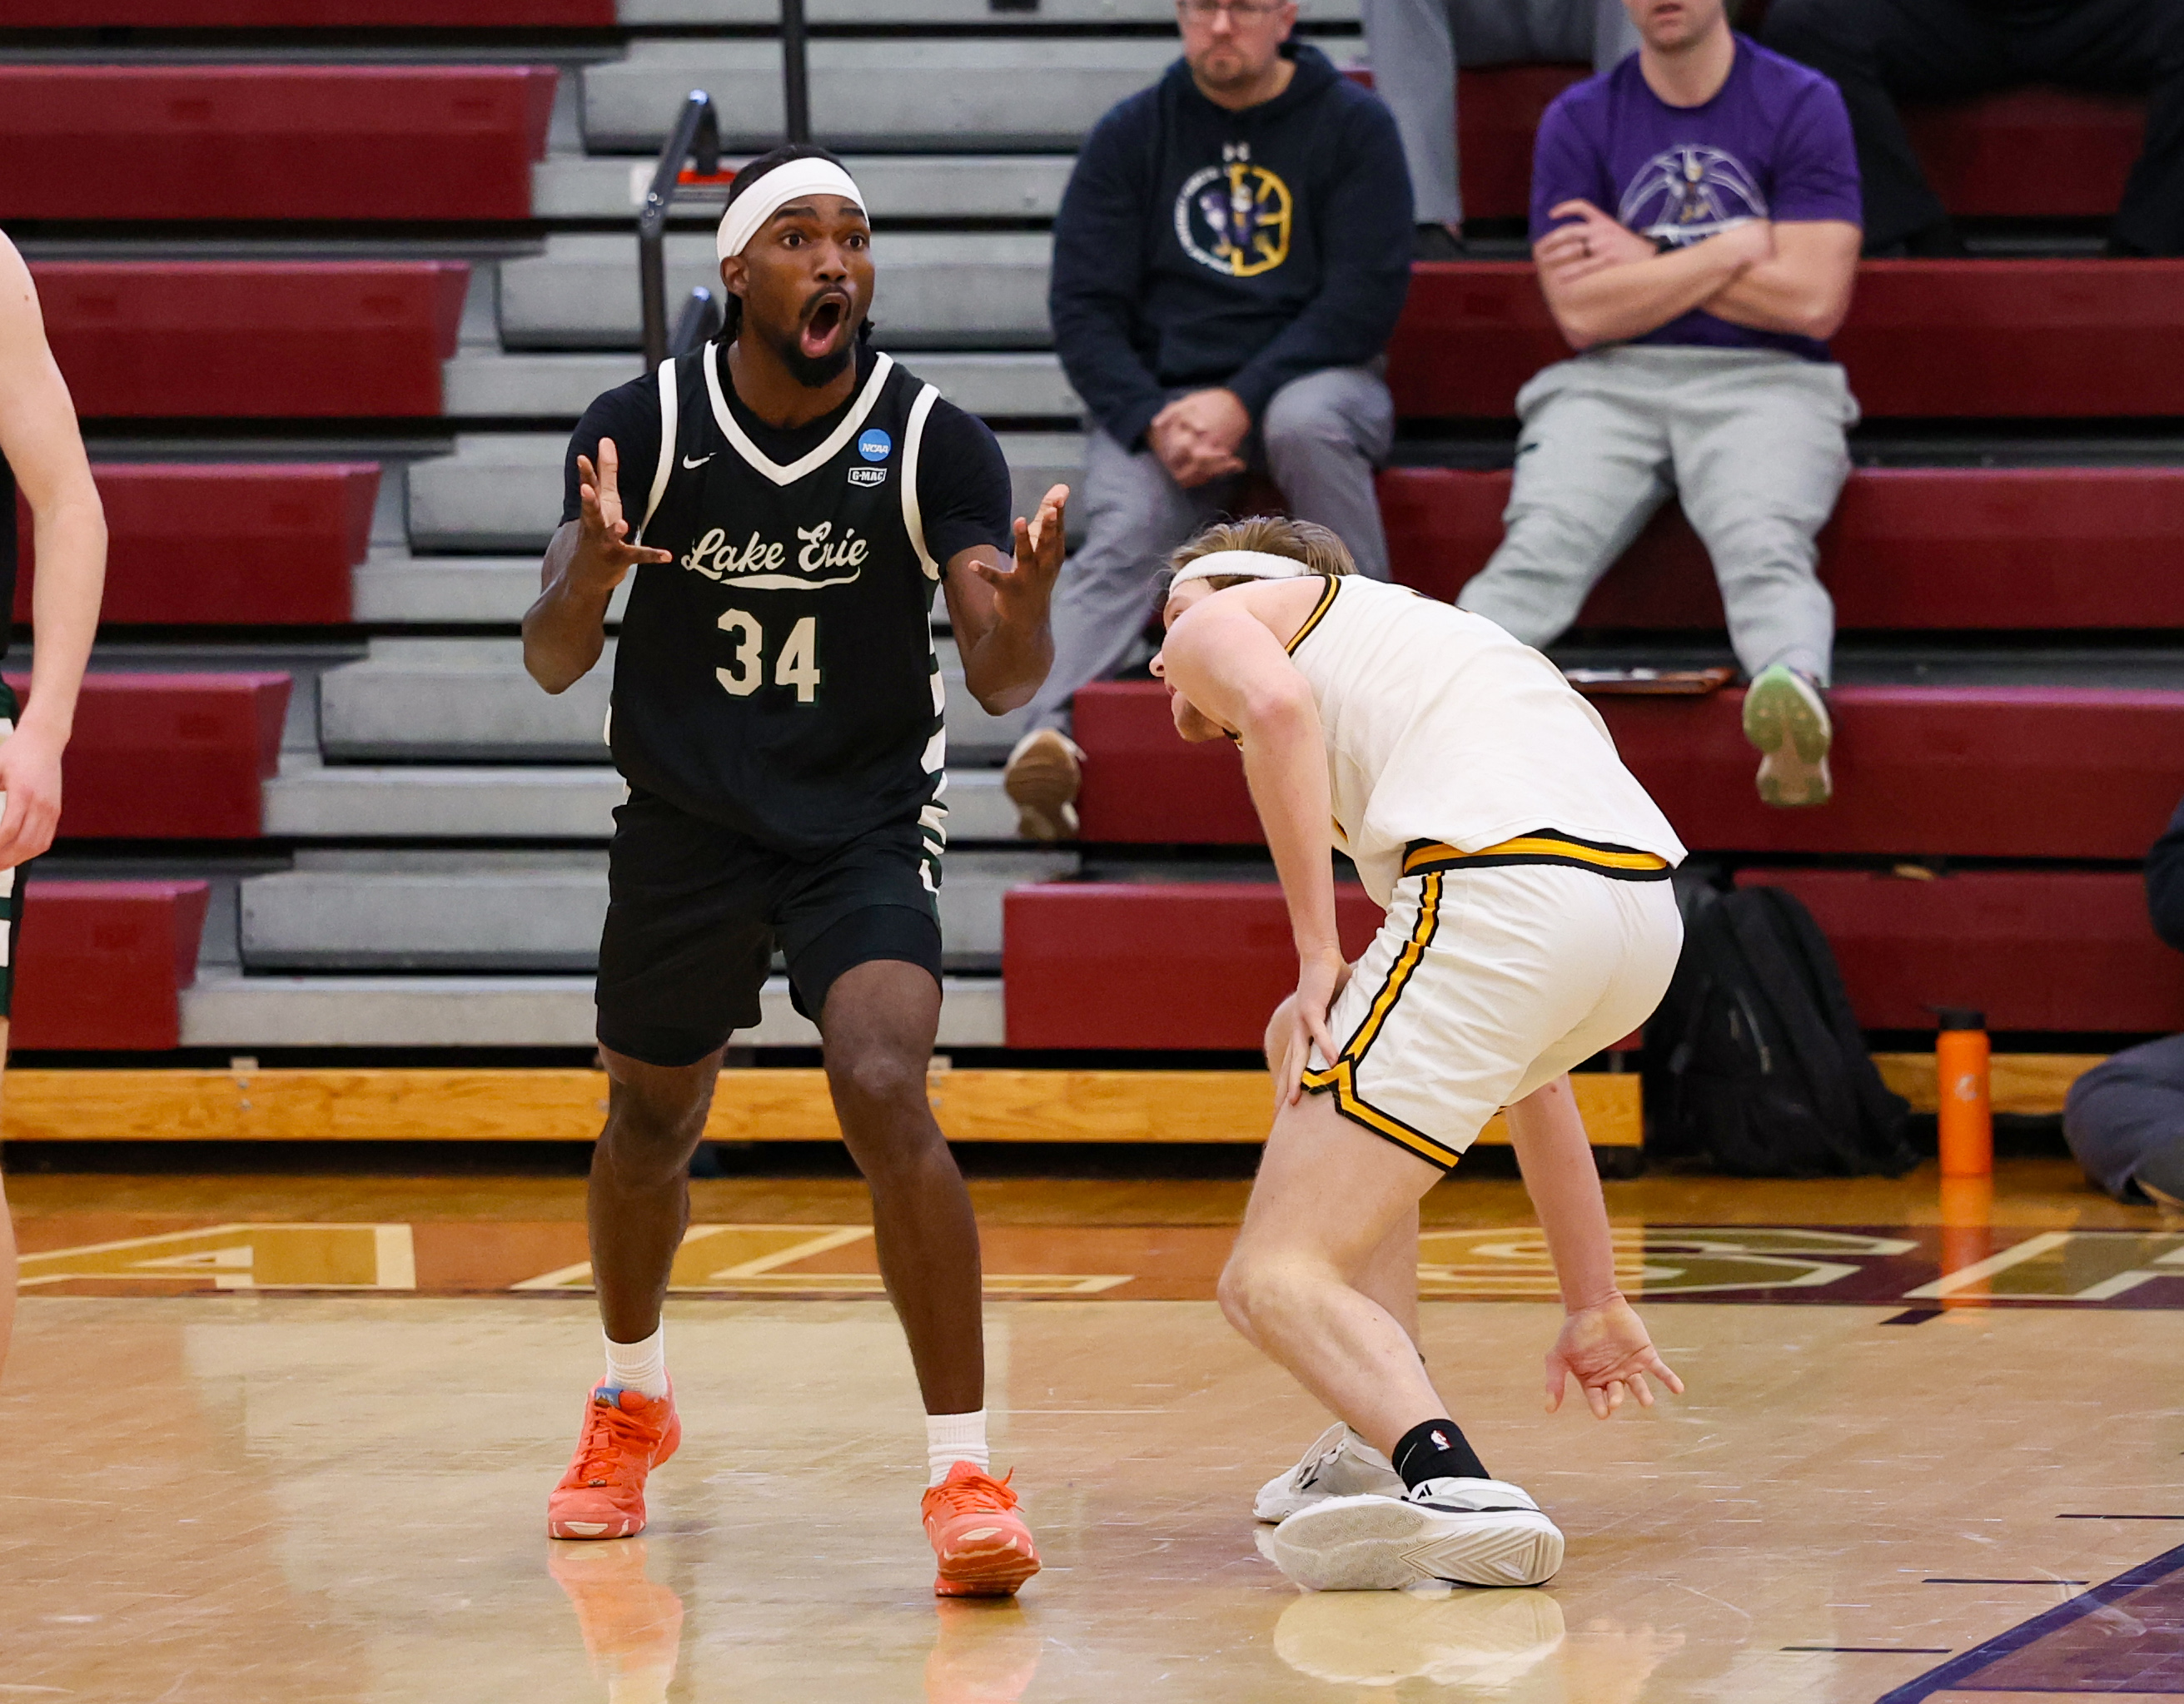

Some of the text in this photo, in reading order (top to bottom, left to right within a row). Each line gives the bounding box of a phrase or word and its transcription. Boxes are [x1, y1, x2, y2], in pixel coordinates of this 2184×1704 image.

[862, 443, 890, 454] NCAA
[681, 521, 869, 580] Lake Erie
[716, 608, 820, 703] 34
